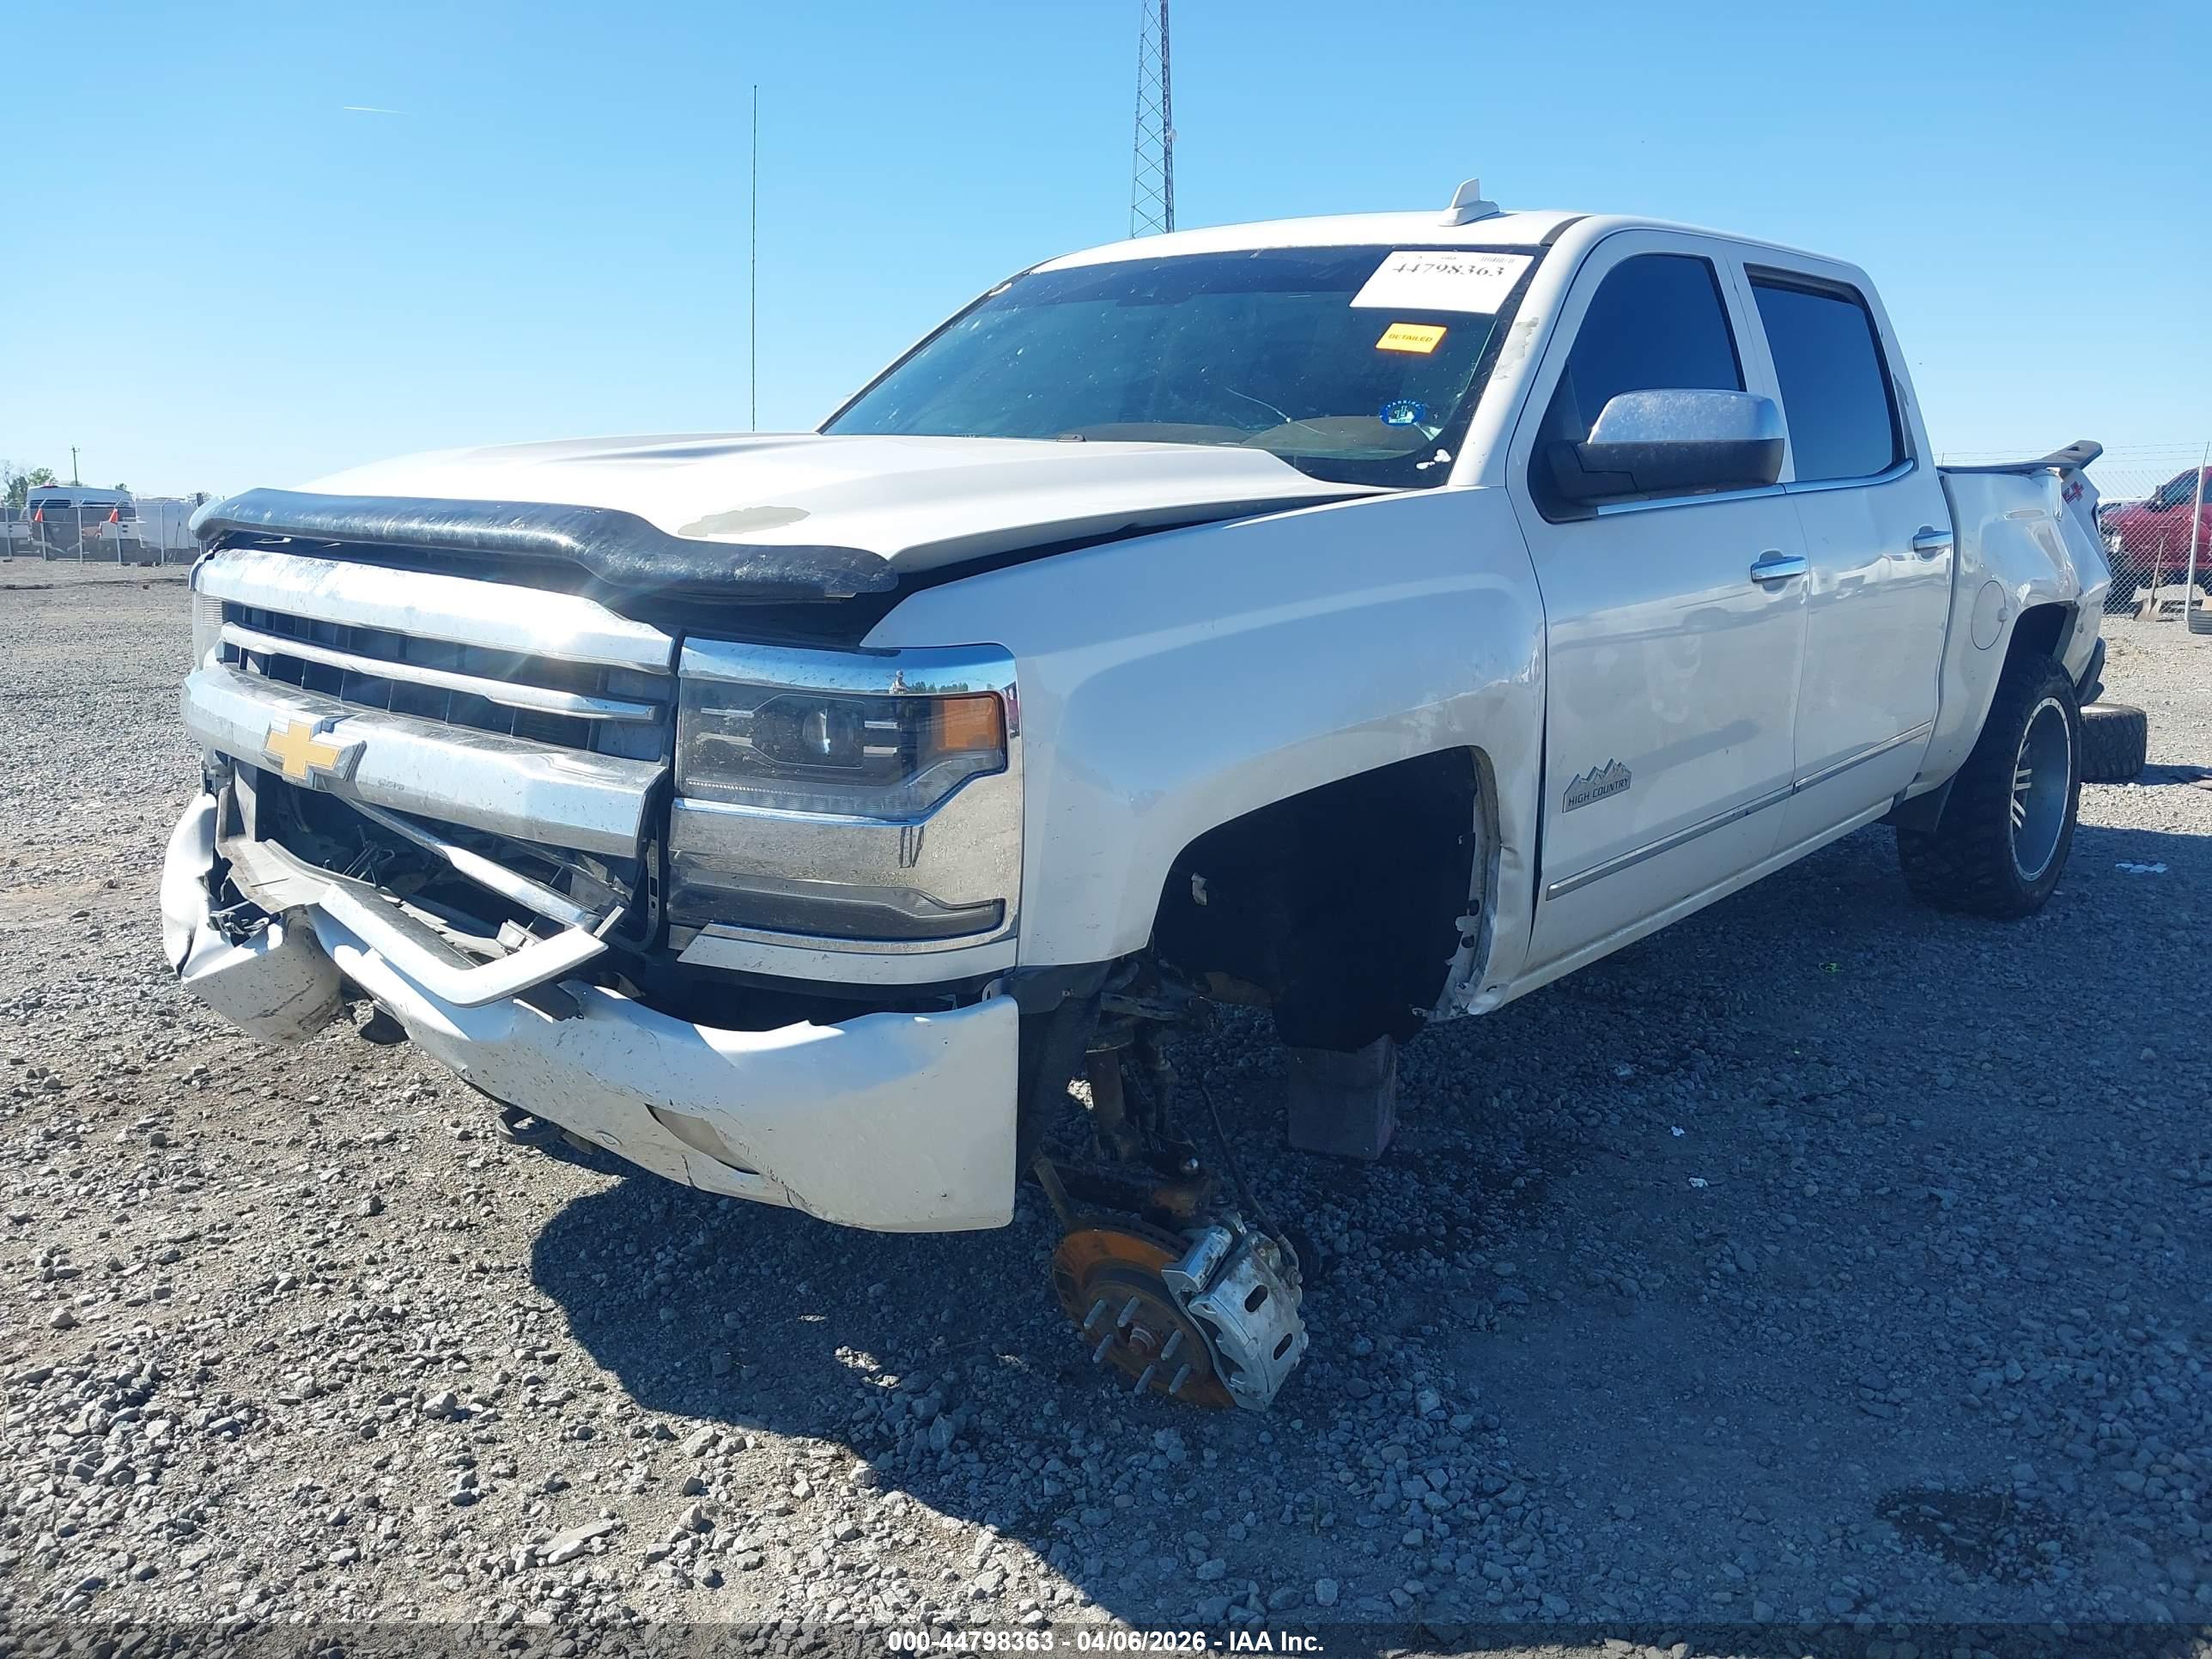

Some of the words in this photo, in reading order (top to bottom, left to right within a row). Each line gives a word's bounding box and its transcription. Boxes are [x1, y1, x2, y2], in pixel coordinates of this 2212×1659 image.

[1393, 262, 1504, 276] 44798363
[1388, 333, 1433, 343] DETAILED
[1568, 791, 1590, 807] HIGH
[1592, 777, 1629, 799] COUNTRY
